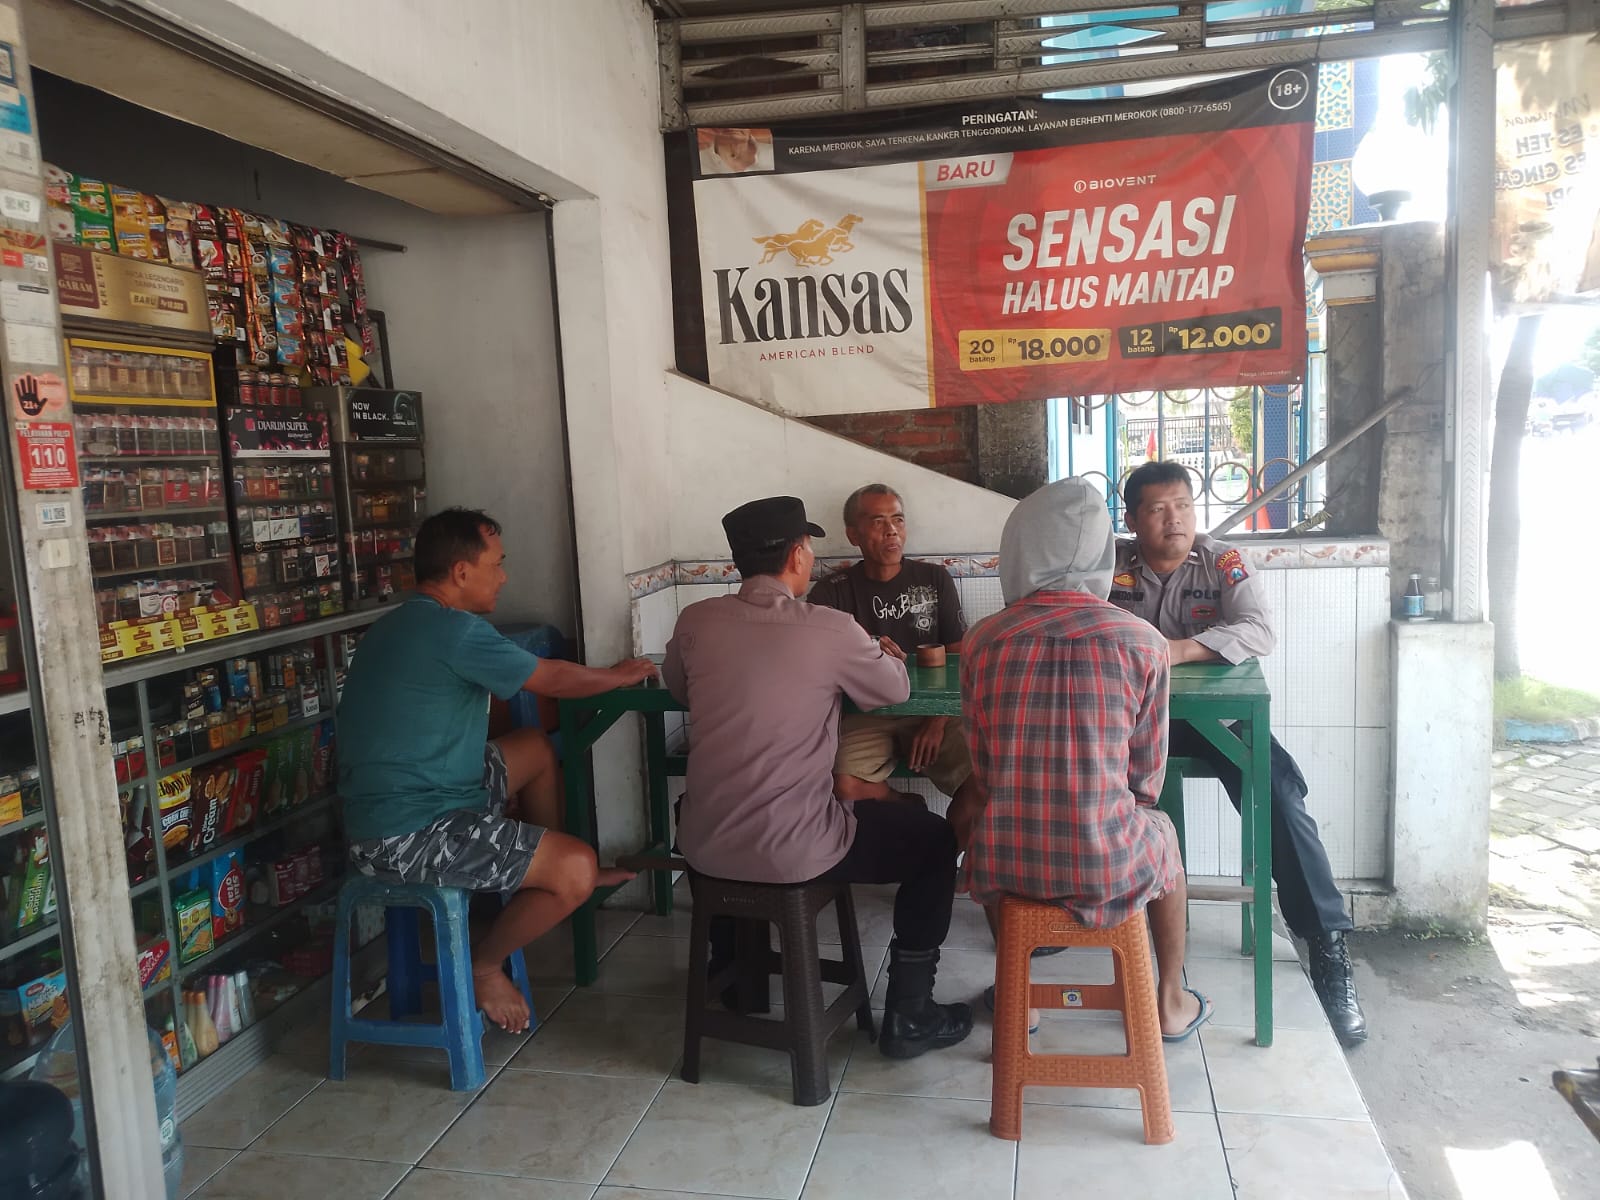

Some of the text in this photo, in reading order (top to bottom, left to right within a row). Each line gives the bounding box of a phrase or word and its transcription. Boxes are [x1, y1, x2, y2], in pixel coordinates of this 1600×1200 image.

[1275, 82, 1301, 97] 18+
[962, 109, 1038, 126] PERINGATAN:
[788, 143, 821, 155] KARENA
[865, 138, 886, 148] SAYA
[888, 134, 925, 146] TERKENA
[926, 130, 960, 142] KANKER
[961, 124, 1027, 138] TENGGOROKAN.
[1028, 119, 1068, 132] LAYANAN
[1070, 114, 1113, 127] BERHENTI
[1114, 109, 1158, 122] MEROKOK
[1159, 101, 1232, 119] (0800-177-6565)
[937, 159, 996, 182] BARU
[1089, 174, 1157, 190] BIOVENT
[1002, 194, 1237, 271] SENSASI
[95, 256, 108, 306] KRETEK
[1002, 265, 1235, 315] HALUS MANTAP
[713, 267, 913, 345] Kansas
[1129, 328, 1153, 347] 12
[760, 344, 875, 362] AMERICAN BLEND
[969, 338, 995, 355] 20
[1127, 345, 1156, 353] batang
[969, 355, 996, 364] batang
[352, 402, 370, 411] NOW
[352, 412, 361, 420] IN
[287, 421, 309, 431] SUPER
[31, 447, 67, 466] 110
